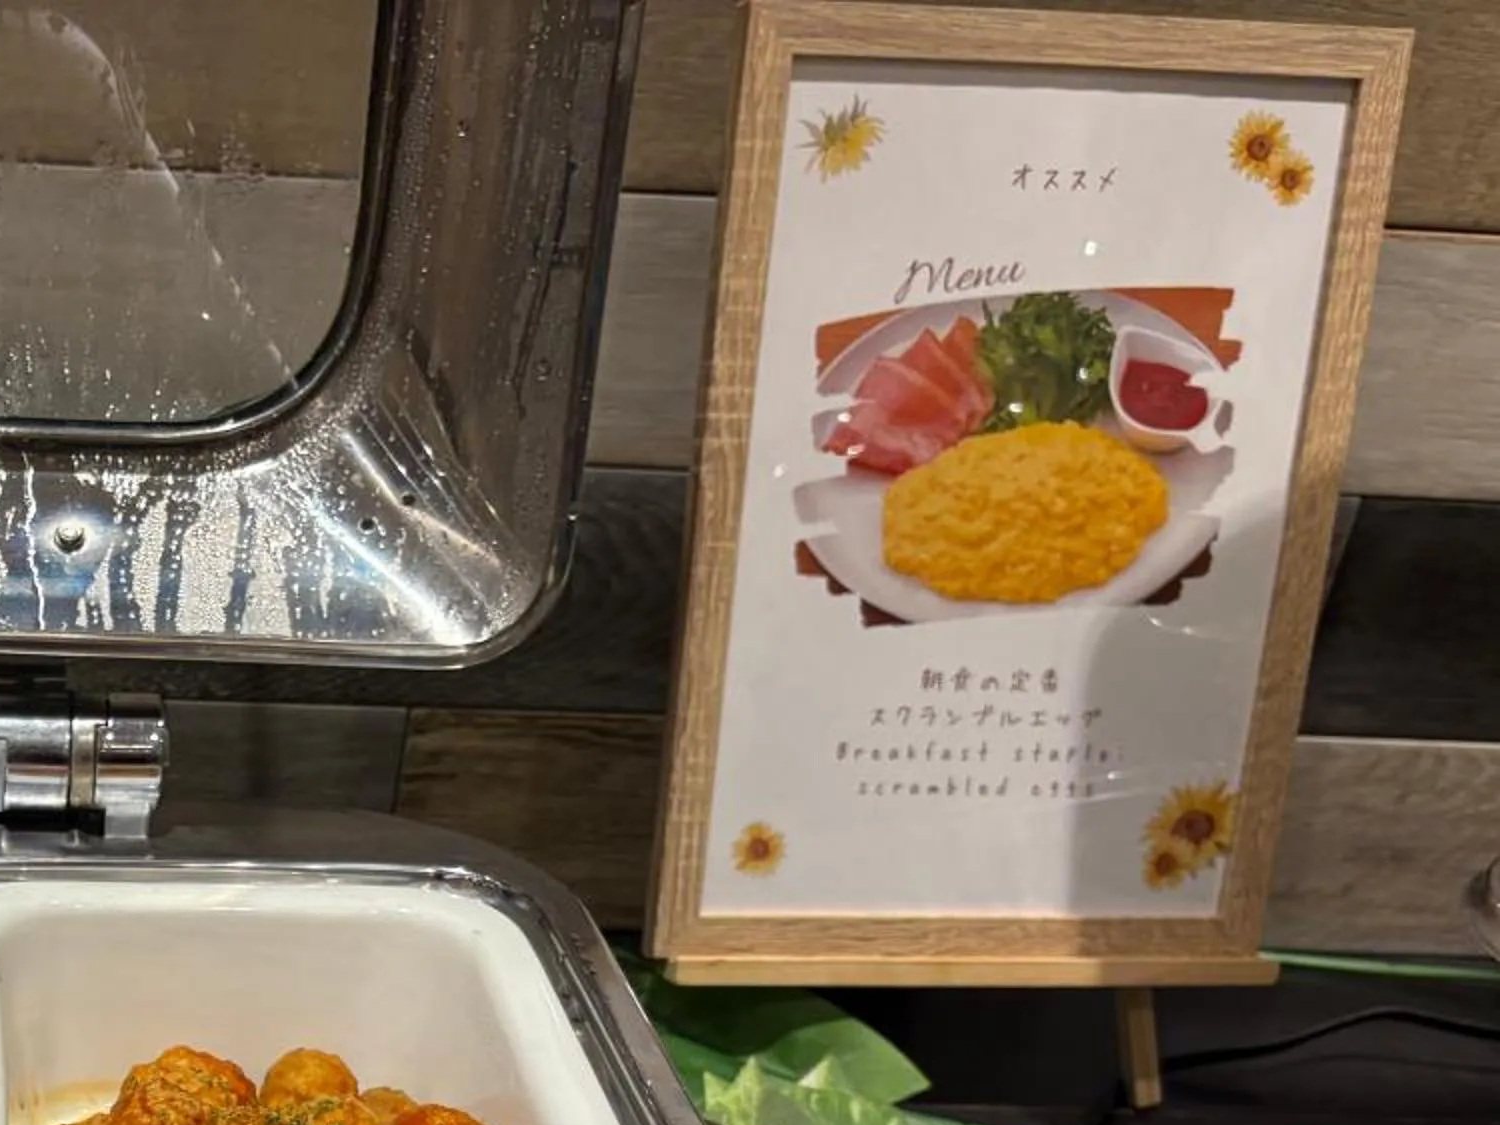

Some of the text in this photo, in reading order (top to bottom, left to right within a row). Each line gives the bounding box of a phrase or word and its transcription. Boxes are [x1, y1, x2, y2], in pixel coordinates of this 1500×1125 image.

[1012, 164, 1116, 192] オススメ
[894, 256, 1026, 305] Menu
[836, 741, 989, 763] Breakfast
[858, 776, 1009, 798] scrambled
